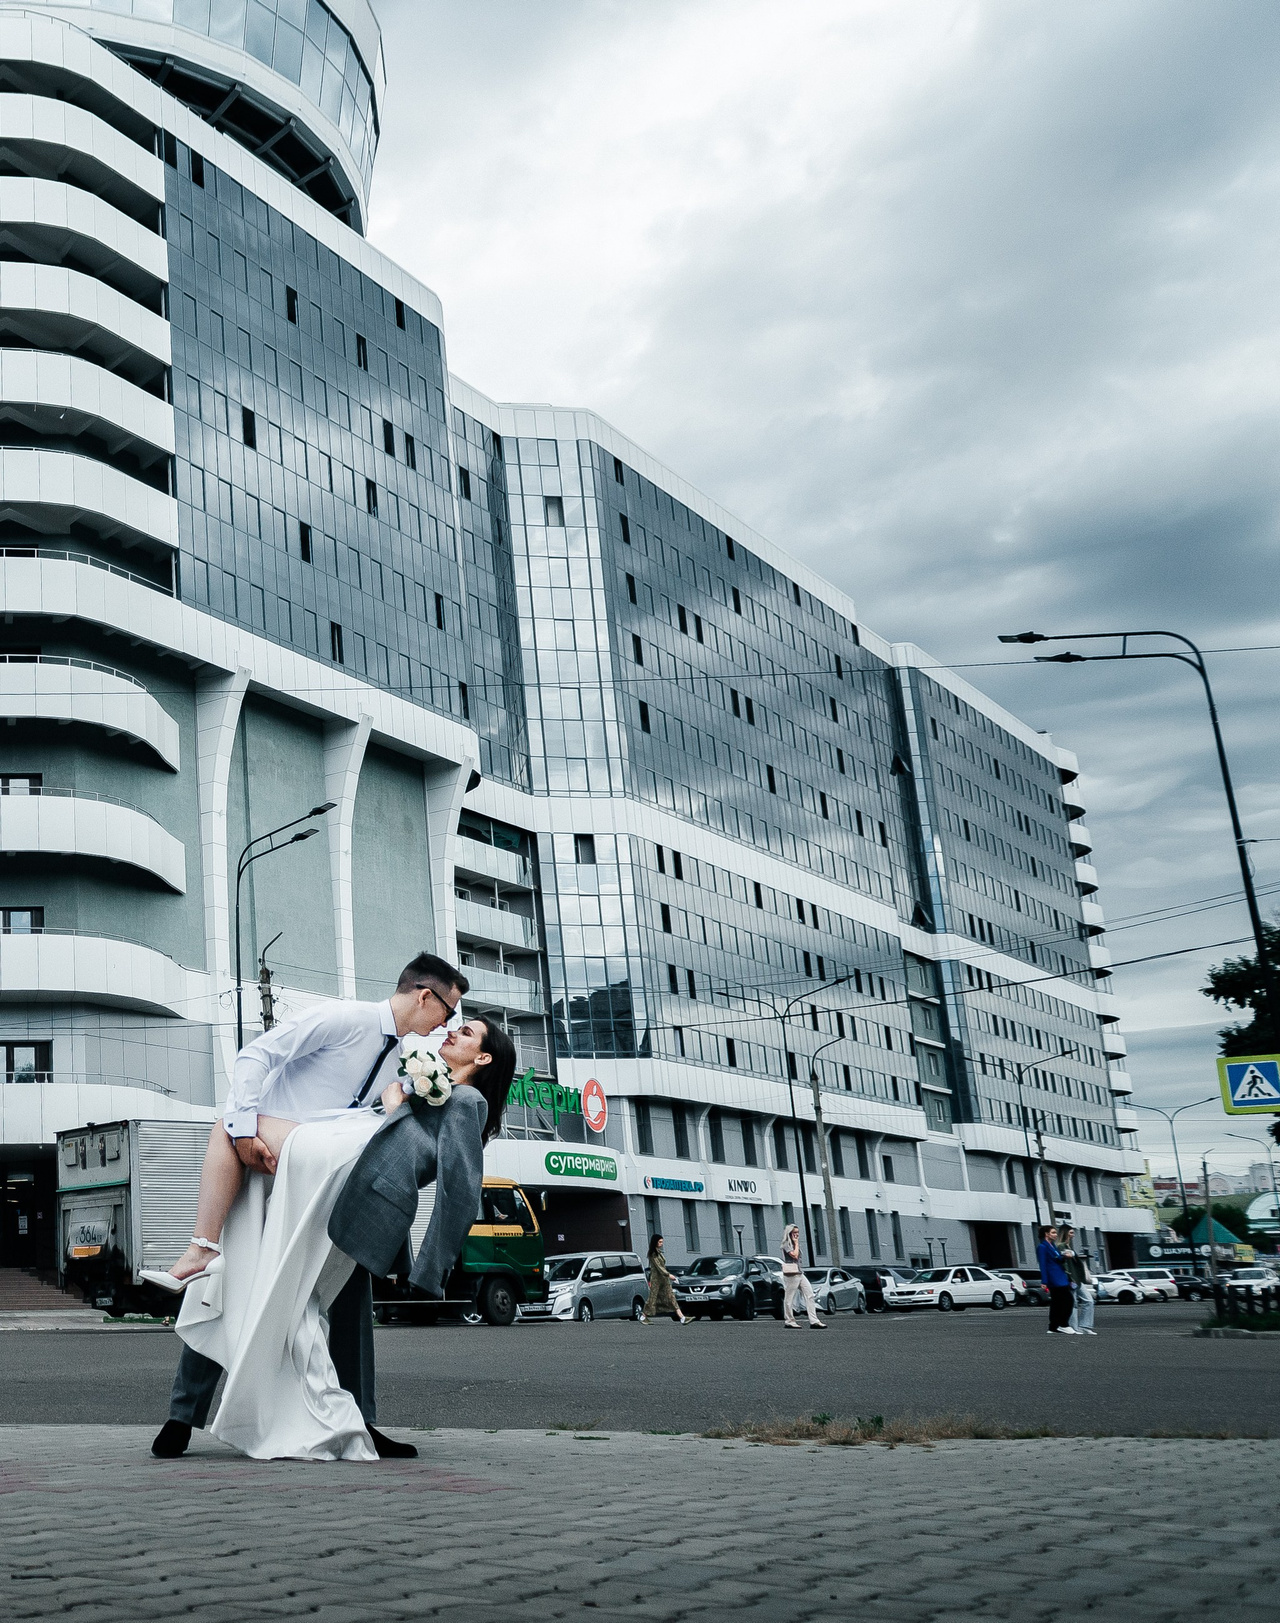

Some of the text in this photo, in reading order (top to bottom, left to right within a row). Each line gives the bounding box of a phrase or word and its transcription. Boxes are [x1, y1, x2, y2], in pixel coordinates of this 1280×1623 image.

[507, 1066, 580, 1125] мбери
[549, 1155, 616, 1177] супермаркет
[727, 1179, 757, 1194] KINWO
[80, 1225, 96, 1243] 384
